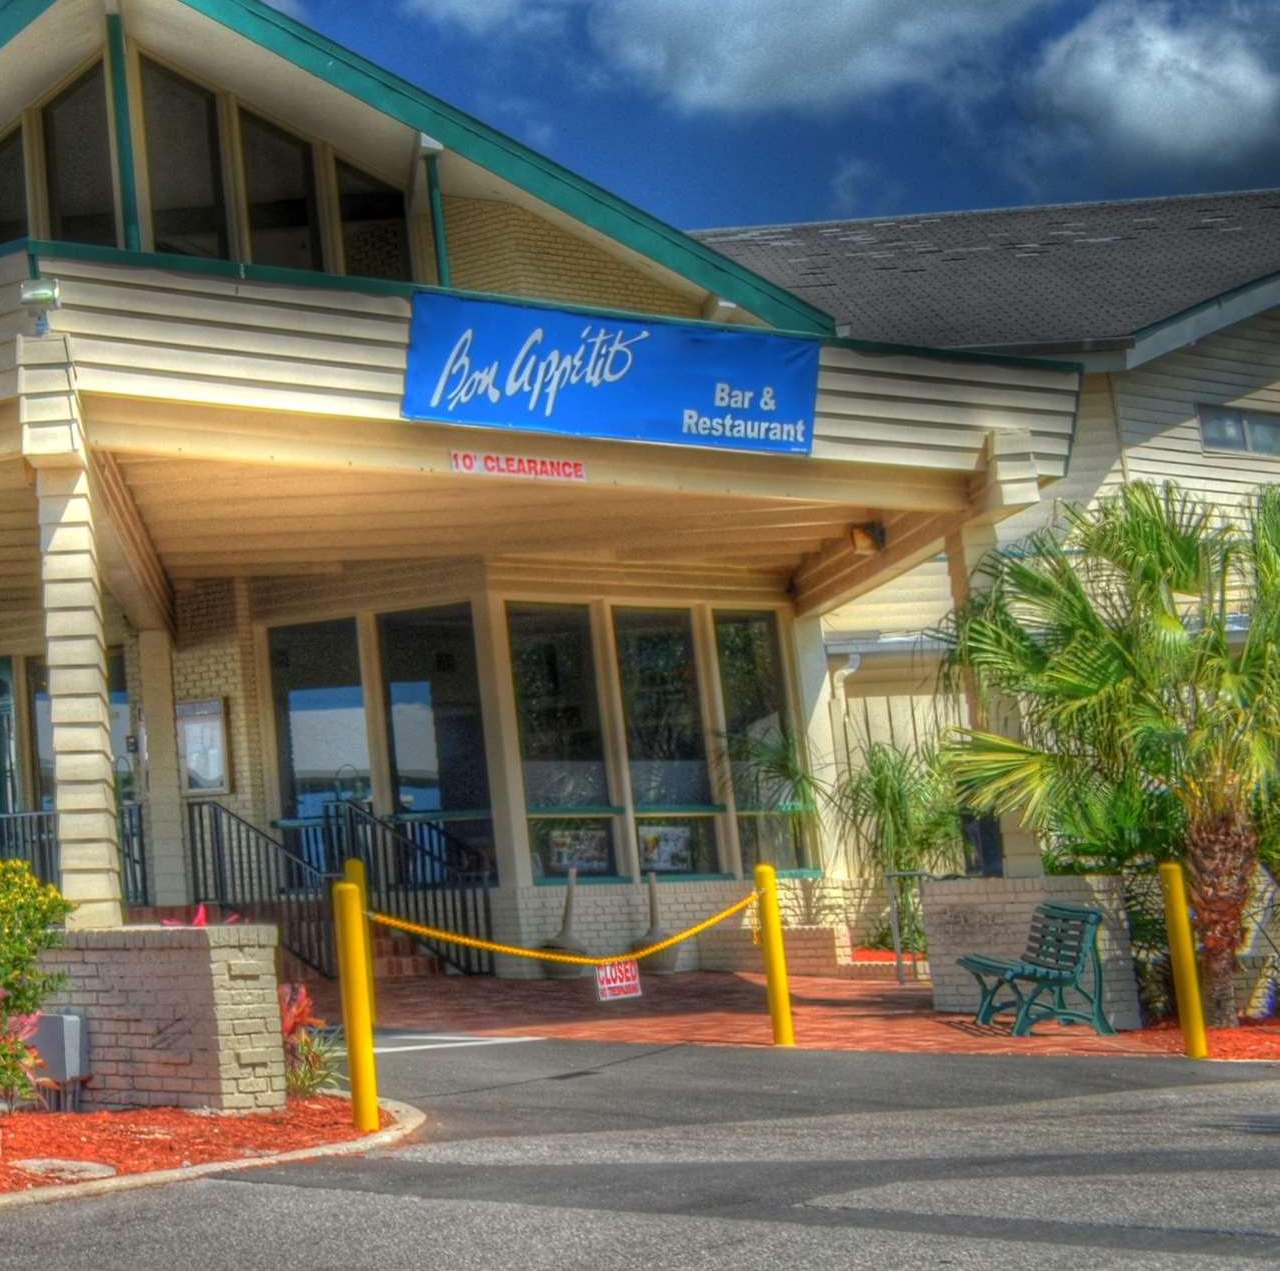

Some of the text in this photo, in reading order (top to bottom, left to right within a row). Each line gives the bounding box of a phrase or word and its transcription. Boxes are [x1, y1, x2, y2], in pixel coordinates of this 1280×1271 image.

[429, 328, 501, 411] Bon
[714, 382, 776, 411] Bar &
[682, 409, 806, 443] Restaurant
[483, 455, 584, 478] CLEARANCE
[597, 960, 638, 985] CLOSED
